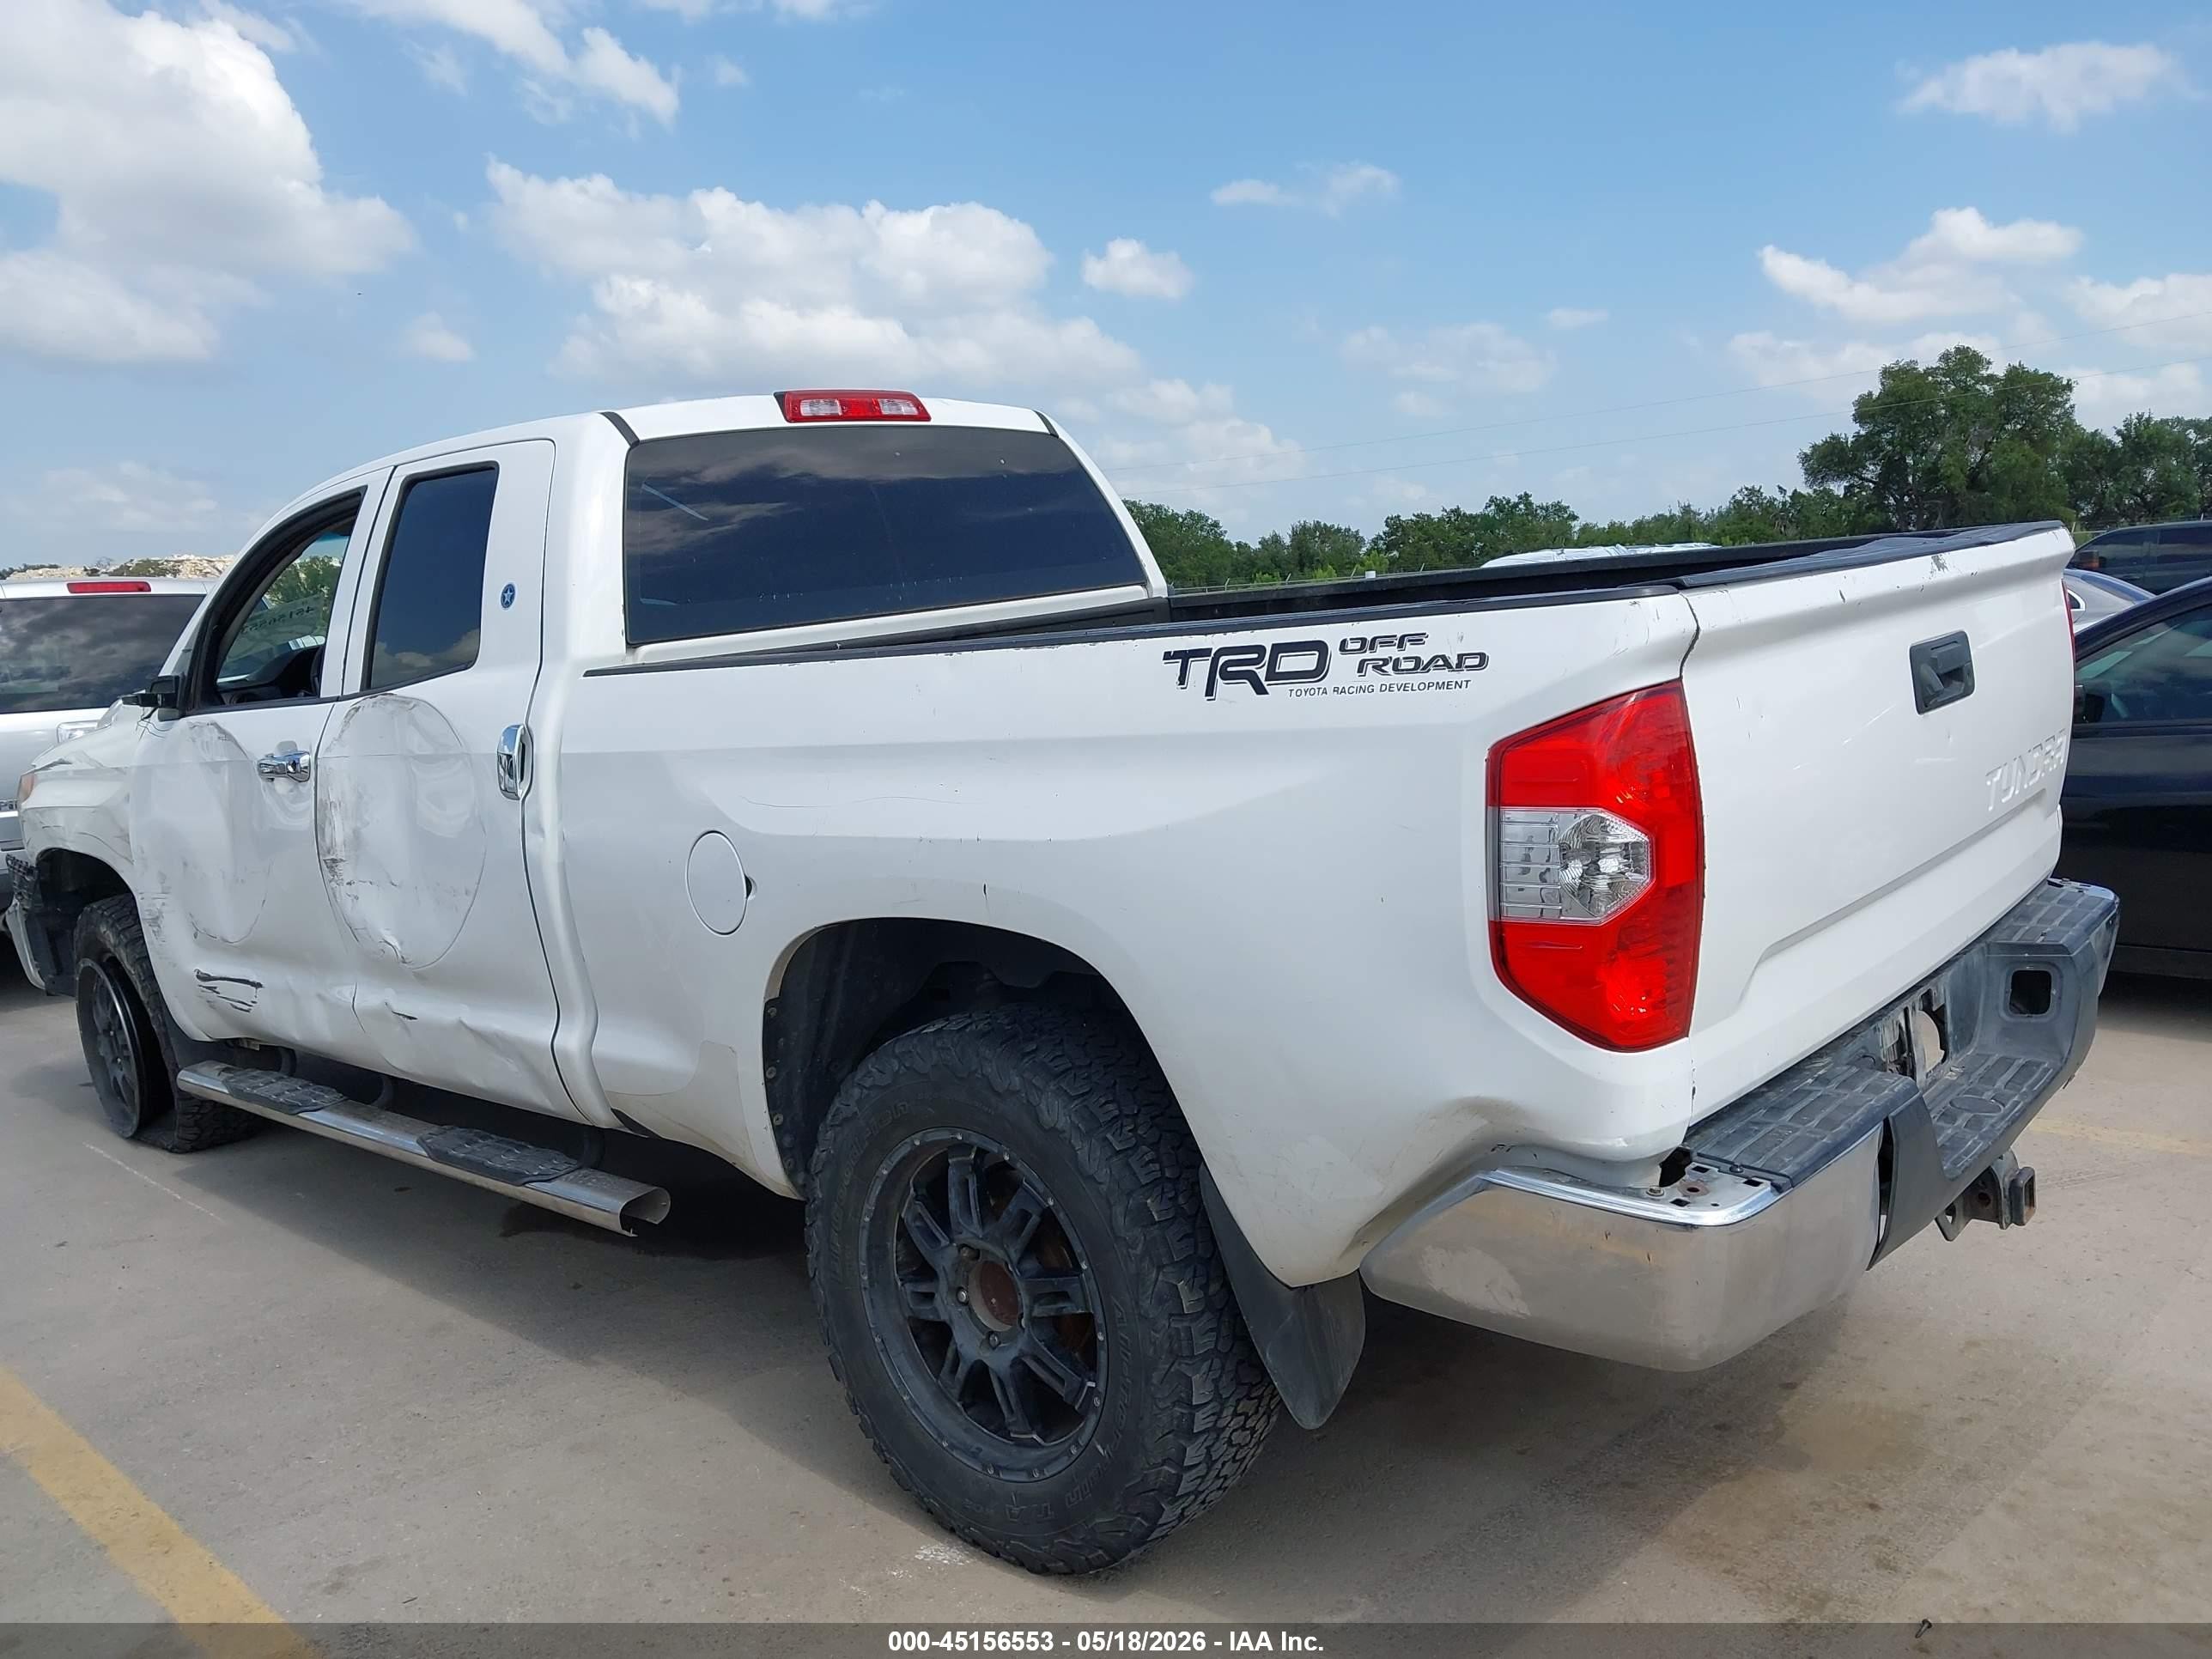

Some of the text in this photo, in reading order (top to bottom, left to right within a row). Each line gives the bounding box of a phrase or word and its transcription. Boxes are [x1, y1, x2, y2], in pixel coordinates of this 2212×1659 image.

[1338, 632, 1429, 655] OFF
[1162, 639, 1332, 701] TRD
[1356, 652, 1490, 678] ROAD
[1288, 679, 1472, 697] TOYOTA RACING DEVELOPMENT
